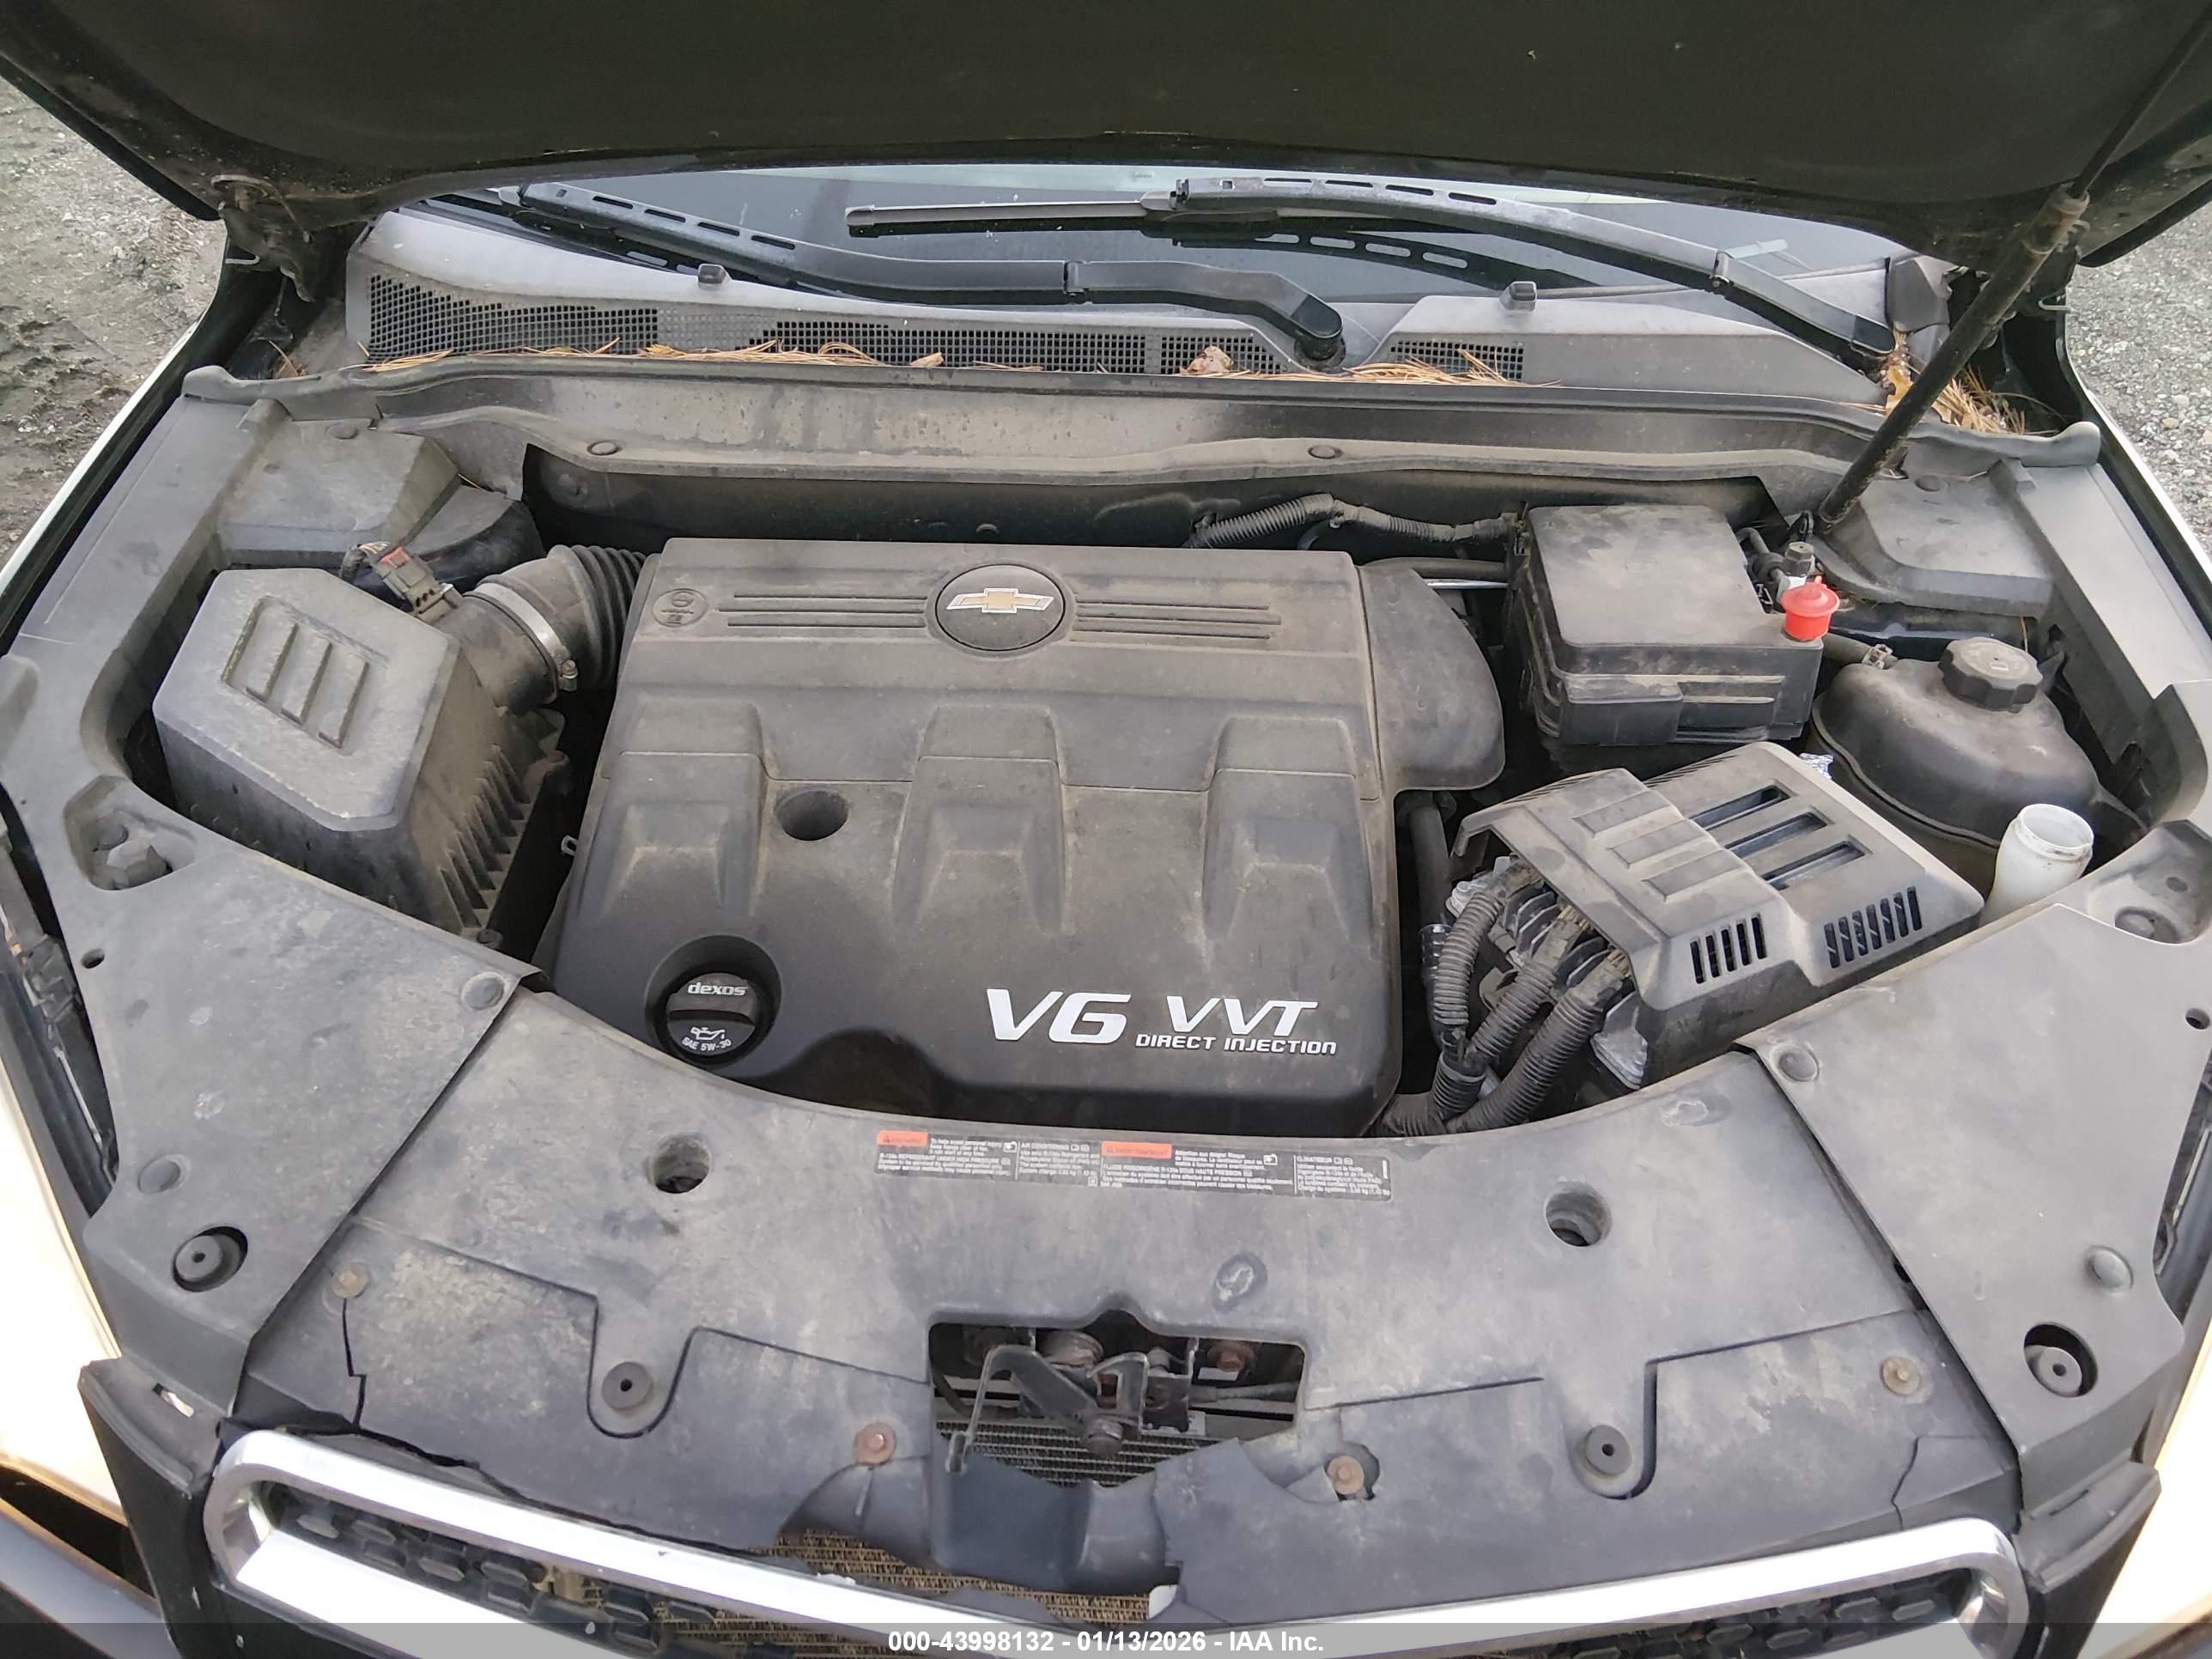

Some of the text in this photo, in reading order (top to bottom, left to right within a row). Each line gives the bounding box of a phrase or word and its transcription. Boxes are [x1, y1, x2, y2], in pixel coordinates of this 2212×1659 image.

[688, 982, 749, 995] dexos
[986, 988, 1319, 1045] V6 VVT
[682, 1037, 732, 1051] SAE 5W-30
[1134, 1033, 1338, 1055] DIRECT INJECTION
